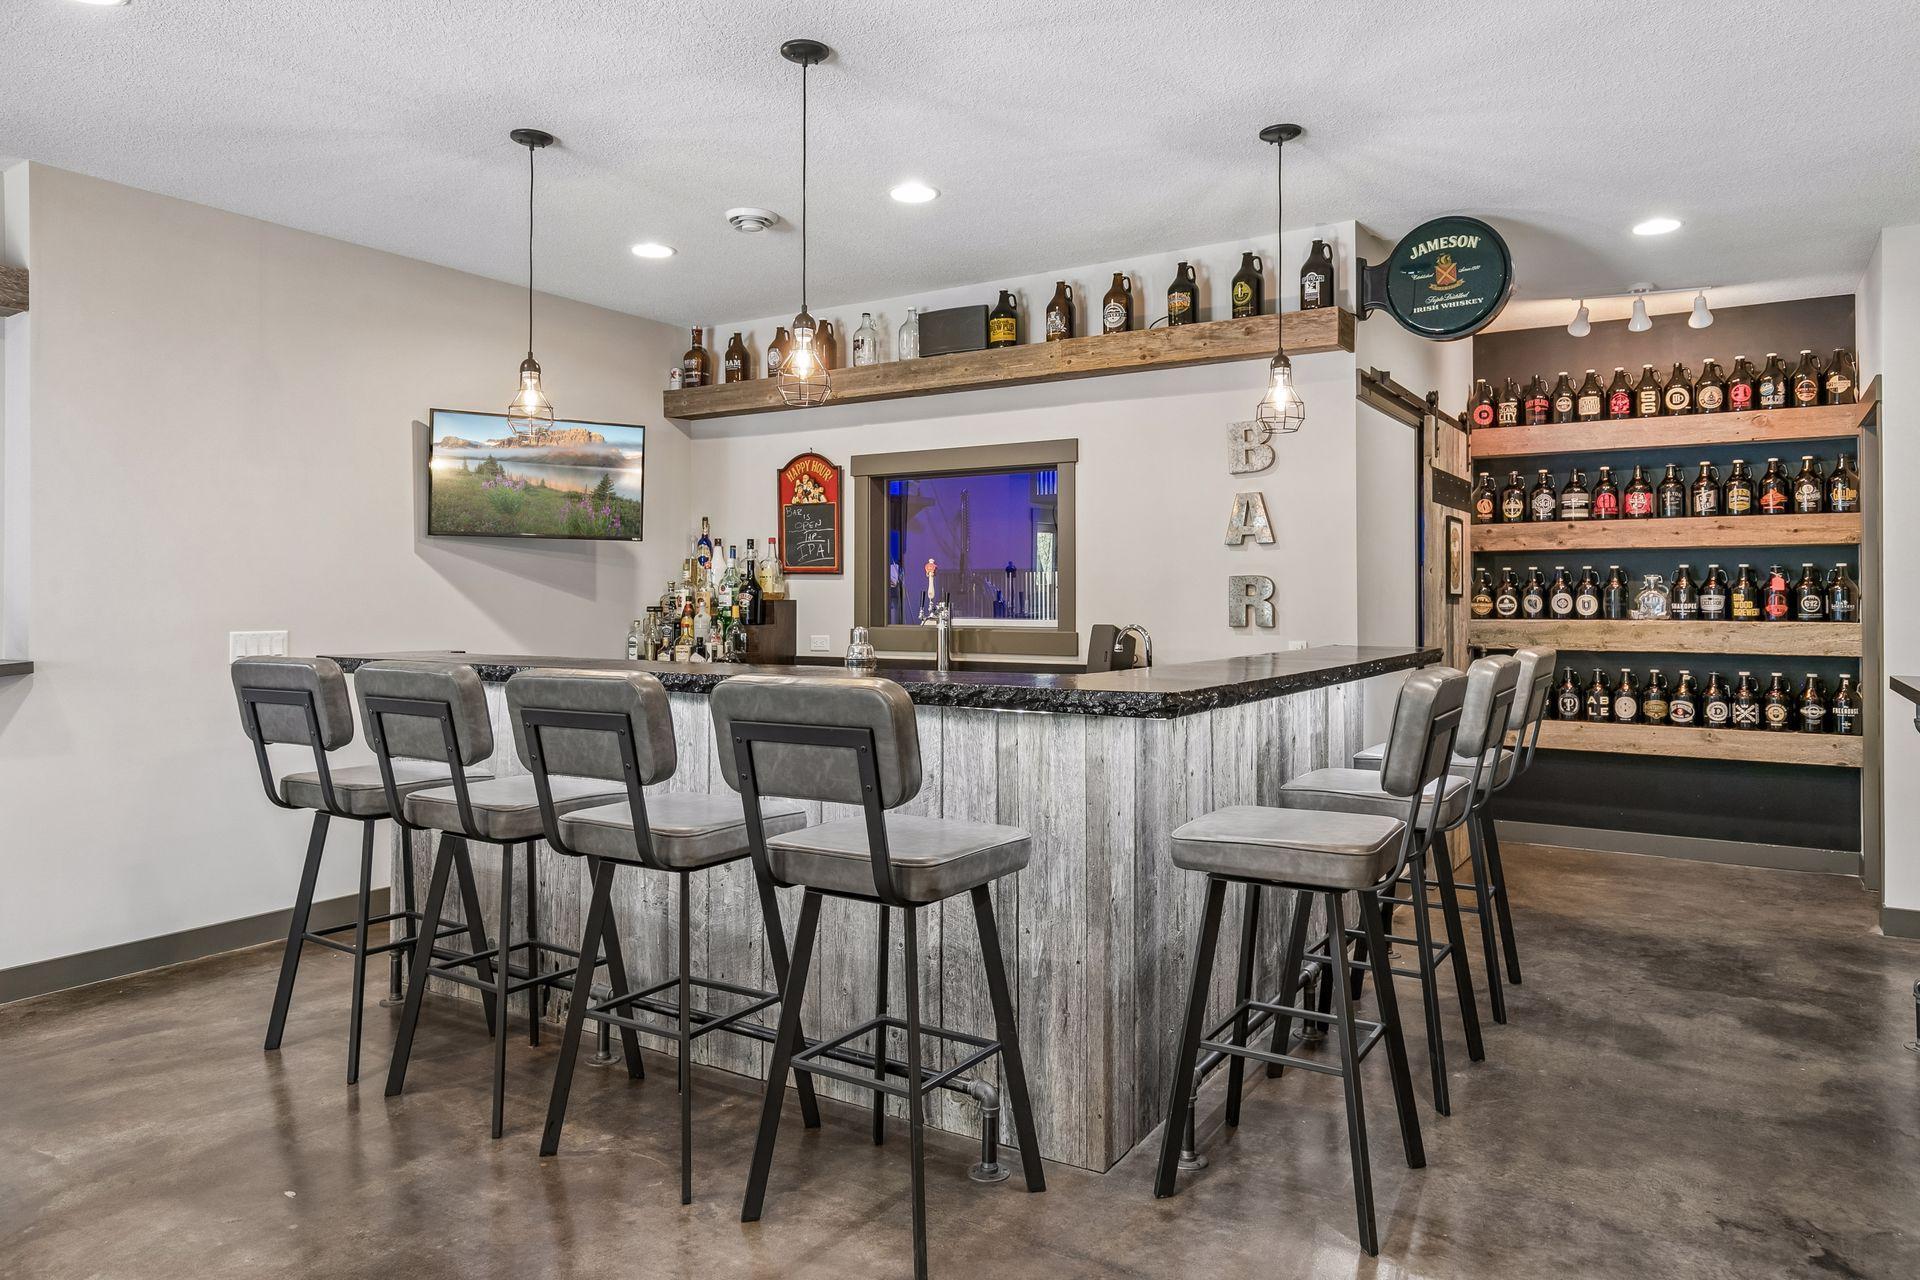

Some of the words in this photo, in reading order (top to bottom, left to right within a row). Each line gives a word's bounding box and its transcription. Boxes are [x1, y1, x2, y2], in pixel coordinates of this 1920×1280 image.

[1410, 234, 1480, 260] JAMESON
[1413, 304, 1439, 314] IRISH
[1441, 297, 1484, 309] WHISKEY
[1499, 412, 1517, 421] CITY
[786, 459, 811, 482] HAPPY
[811, 459, 834, 482] HOUR!
[803, 513, 811, 521] IS
[795, 519, 822, 531] OPEN
[1224, 420, 1276, 628] BAR
[1733, 593, 1745, 601] BIG
[1733, 601, 1753, 609] WOOD
